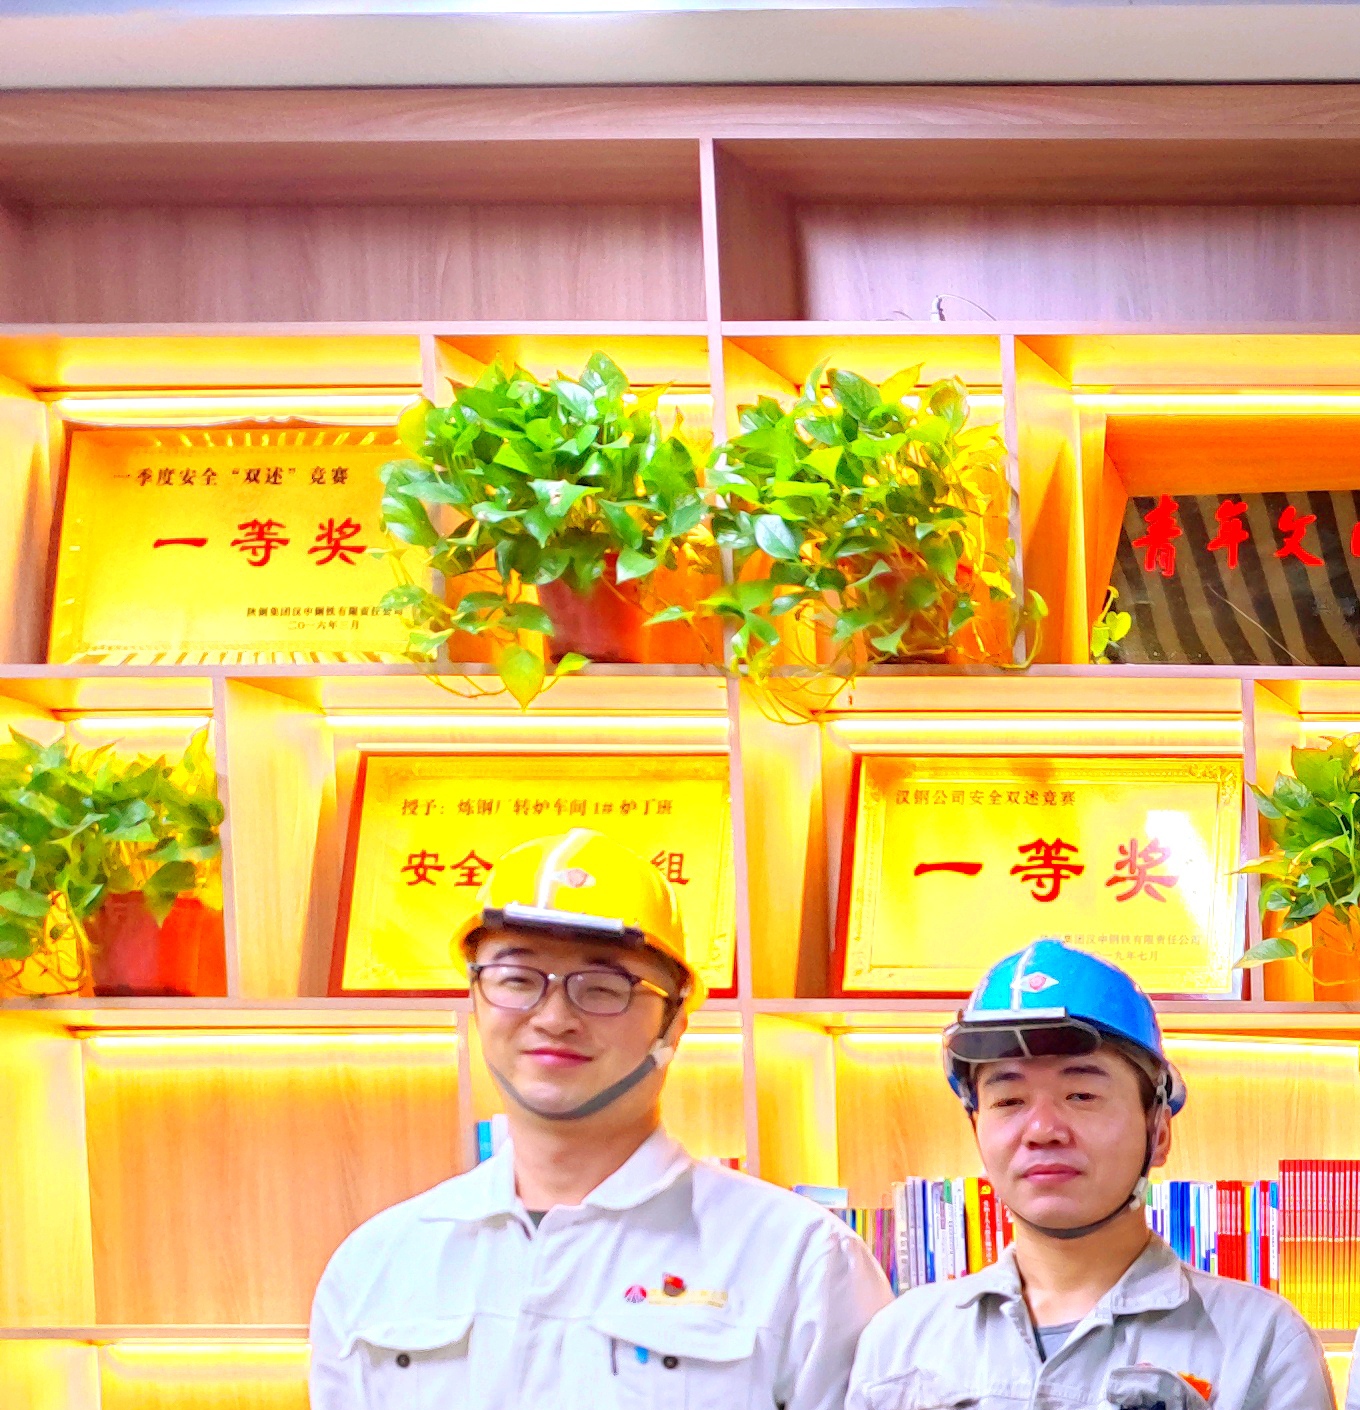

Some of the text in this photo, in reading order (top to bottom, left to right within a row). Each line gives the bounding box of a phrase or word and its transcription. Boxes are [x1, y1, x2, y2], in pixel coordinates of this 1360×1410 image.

[153, 517, 368, 567] 一等奖
[914, 837, 1180, 903] 一等奖
